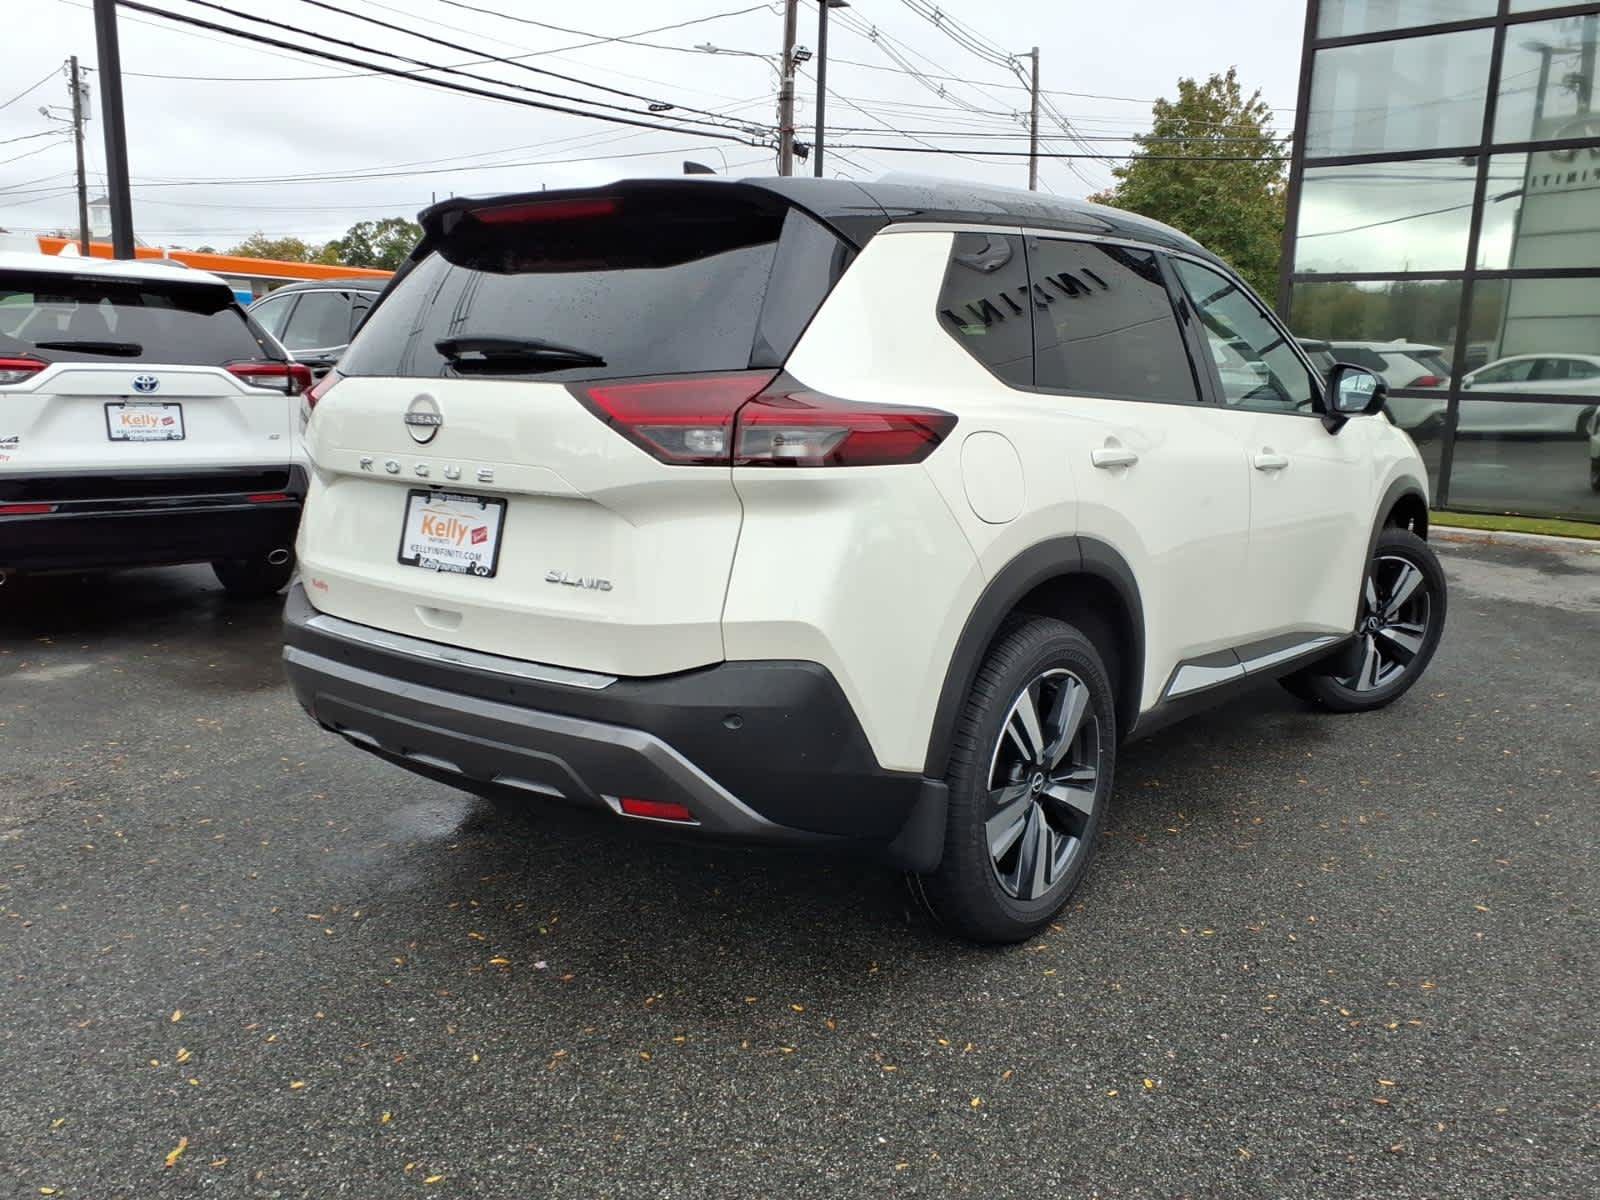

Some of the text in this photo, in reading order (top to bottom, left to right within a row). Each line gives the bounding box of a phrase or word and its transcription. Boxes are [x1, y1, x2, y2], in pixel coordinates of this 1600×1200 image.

[121, 414, 159, 428] Kelly
[360, 456, 495, 483] ROGUE
[421, 514, 468, 546] Kelly
[410, 544, 481, 560] KELLYINFINITI.COM
